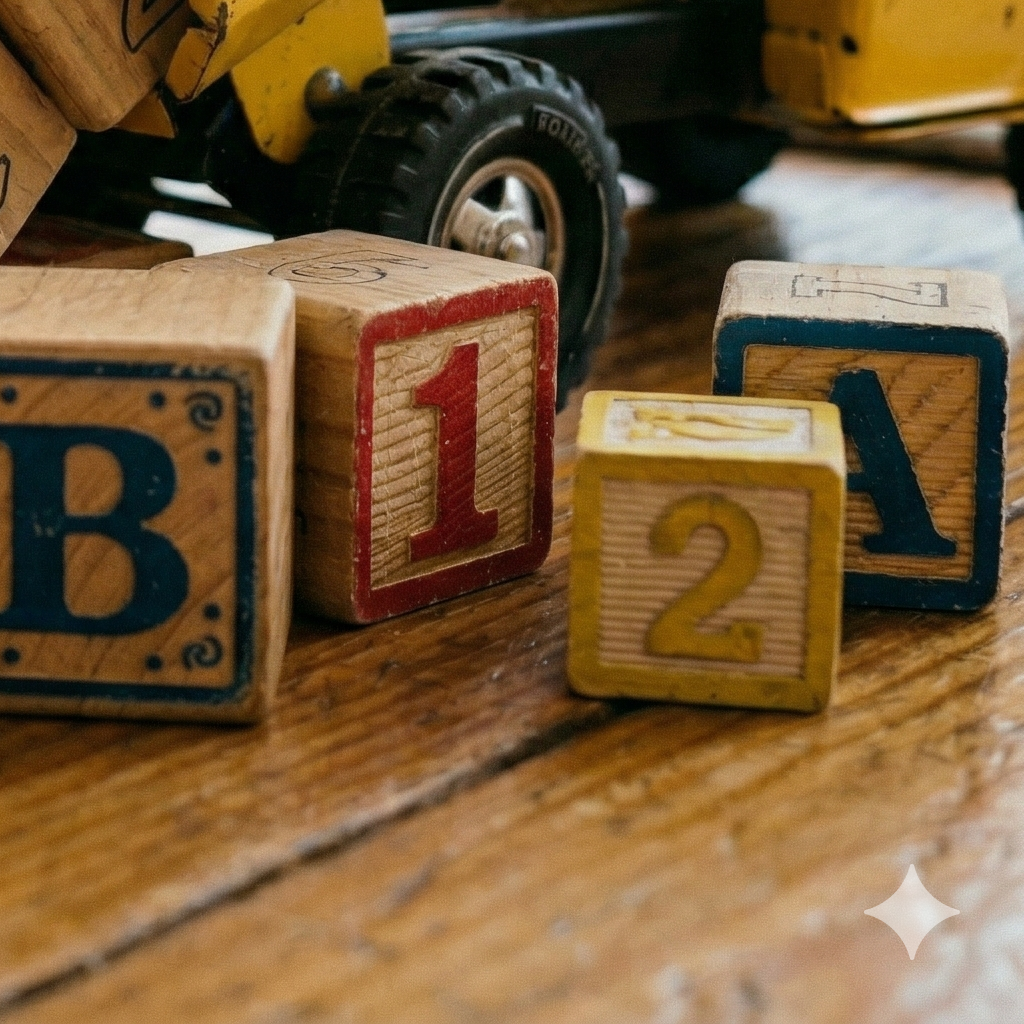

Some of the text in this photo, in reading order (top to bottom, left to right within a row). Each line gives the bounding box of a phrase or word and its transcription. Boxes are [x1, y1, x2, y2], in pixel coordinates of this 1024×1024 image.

[409, 342, 499, 564] 1
[828, 367, 957, 557] A
[642, 491, 766, 664] 2
